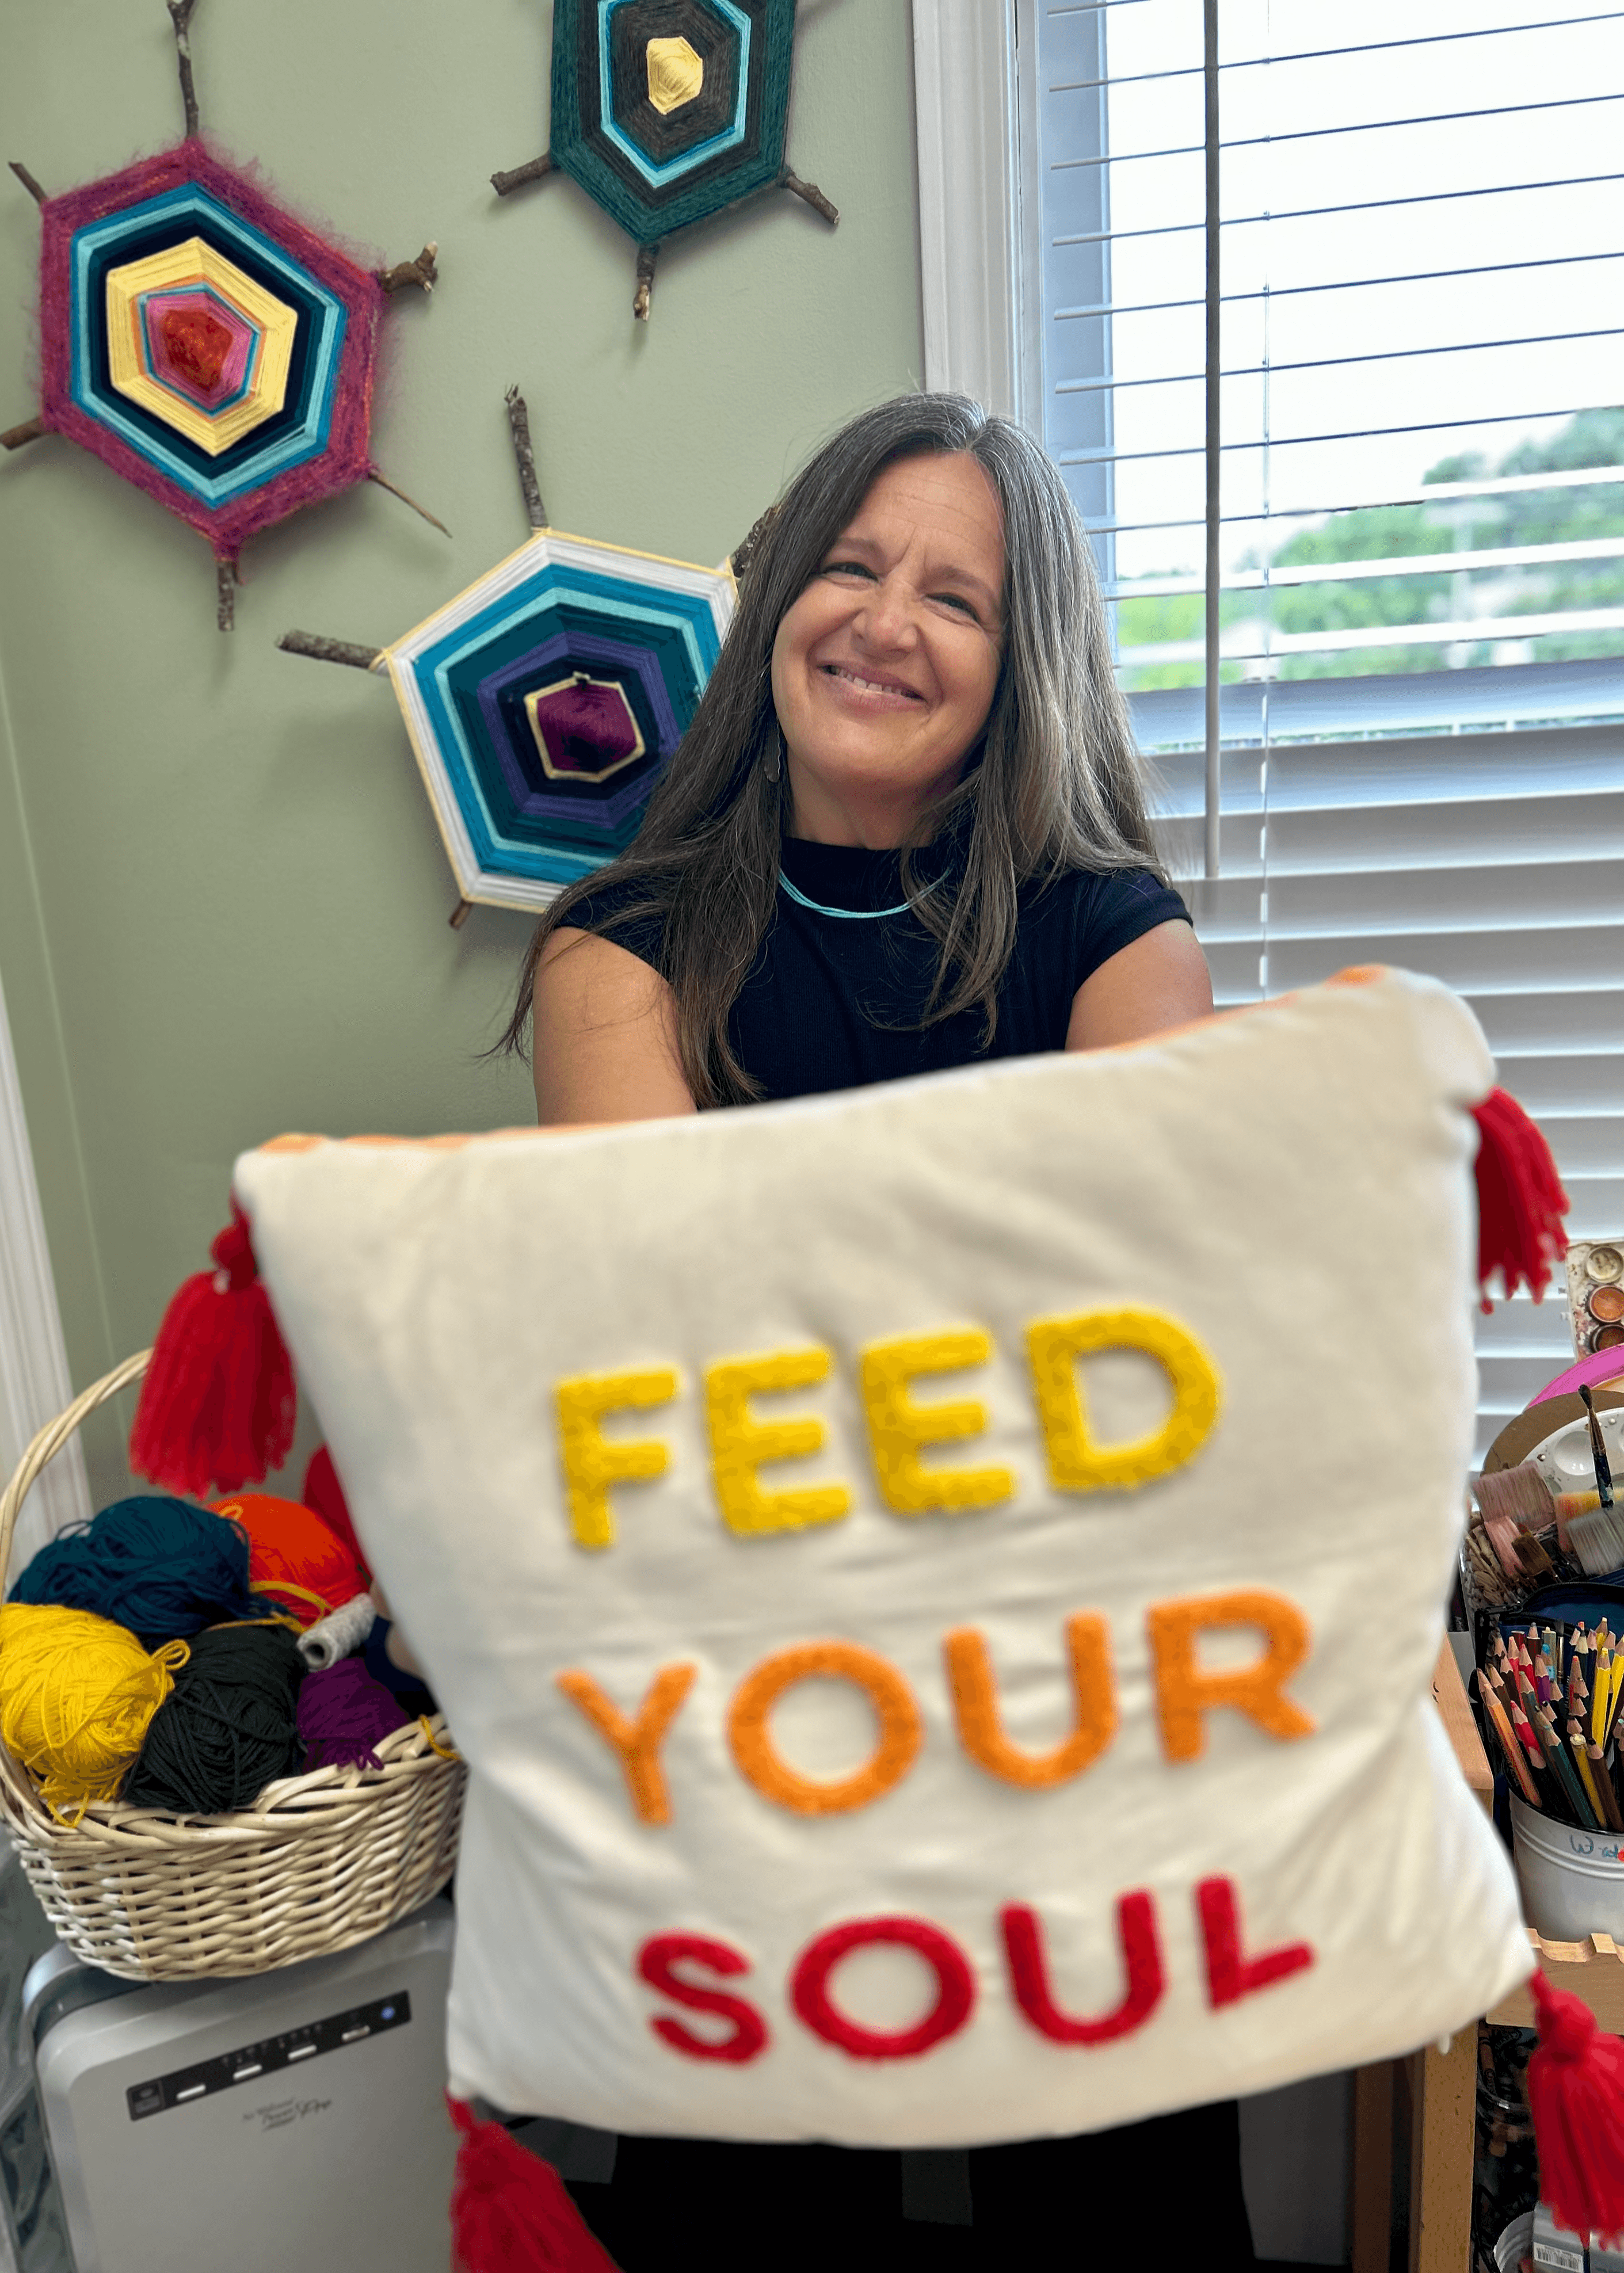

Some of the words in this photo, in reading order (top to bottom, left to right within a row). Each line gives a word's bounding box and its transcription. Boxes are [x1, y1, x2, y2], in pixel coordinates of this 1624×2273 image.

[550, 1305, 1223, 1554] FEED
[558, 1589, 1318, 1828] YOUR
[635, 1872, 1314, 2066] SOUL
